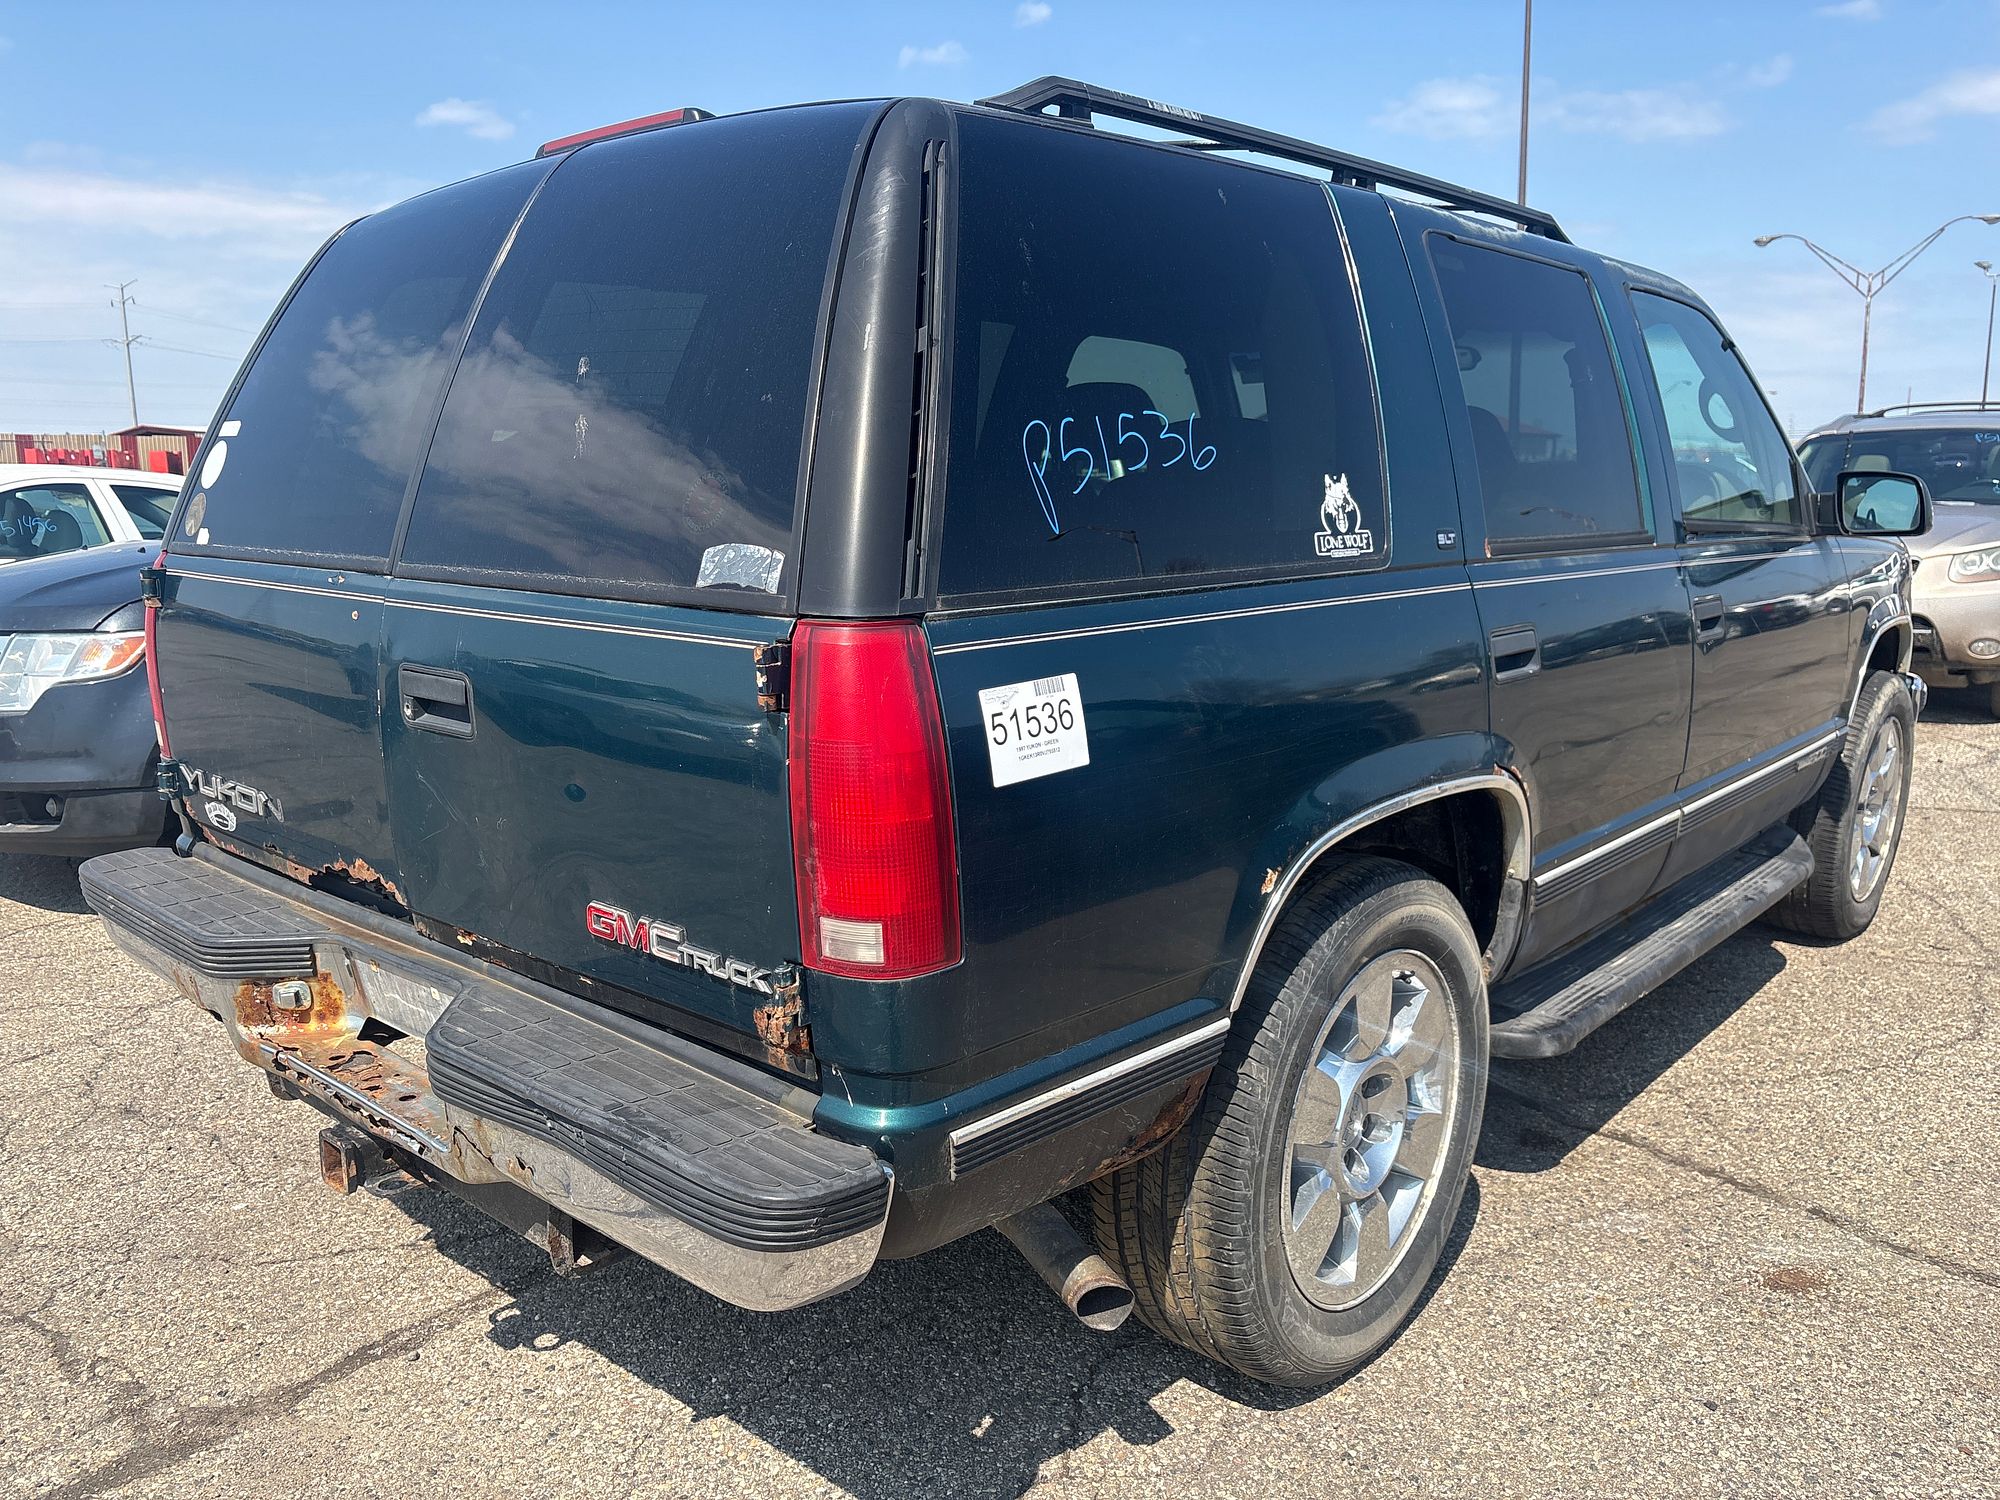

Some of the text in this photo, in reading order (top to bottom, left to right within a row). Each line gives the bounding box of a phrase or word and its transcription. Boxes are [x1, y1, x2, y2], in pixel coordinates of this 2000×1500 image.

[1319, 533, 1369, 551] LONE WOLF
[1437, 533, 1456, 545] SLT
[991, 698, 1074, 746] 51536
[179, 762, 285, 823] YUKON
[586, 900, 774, 995] GMC TRUCK
